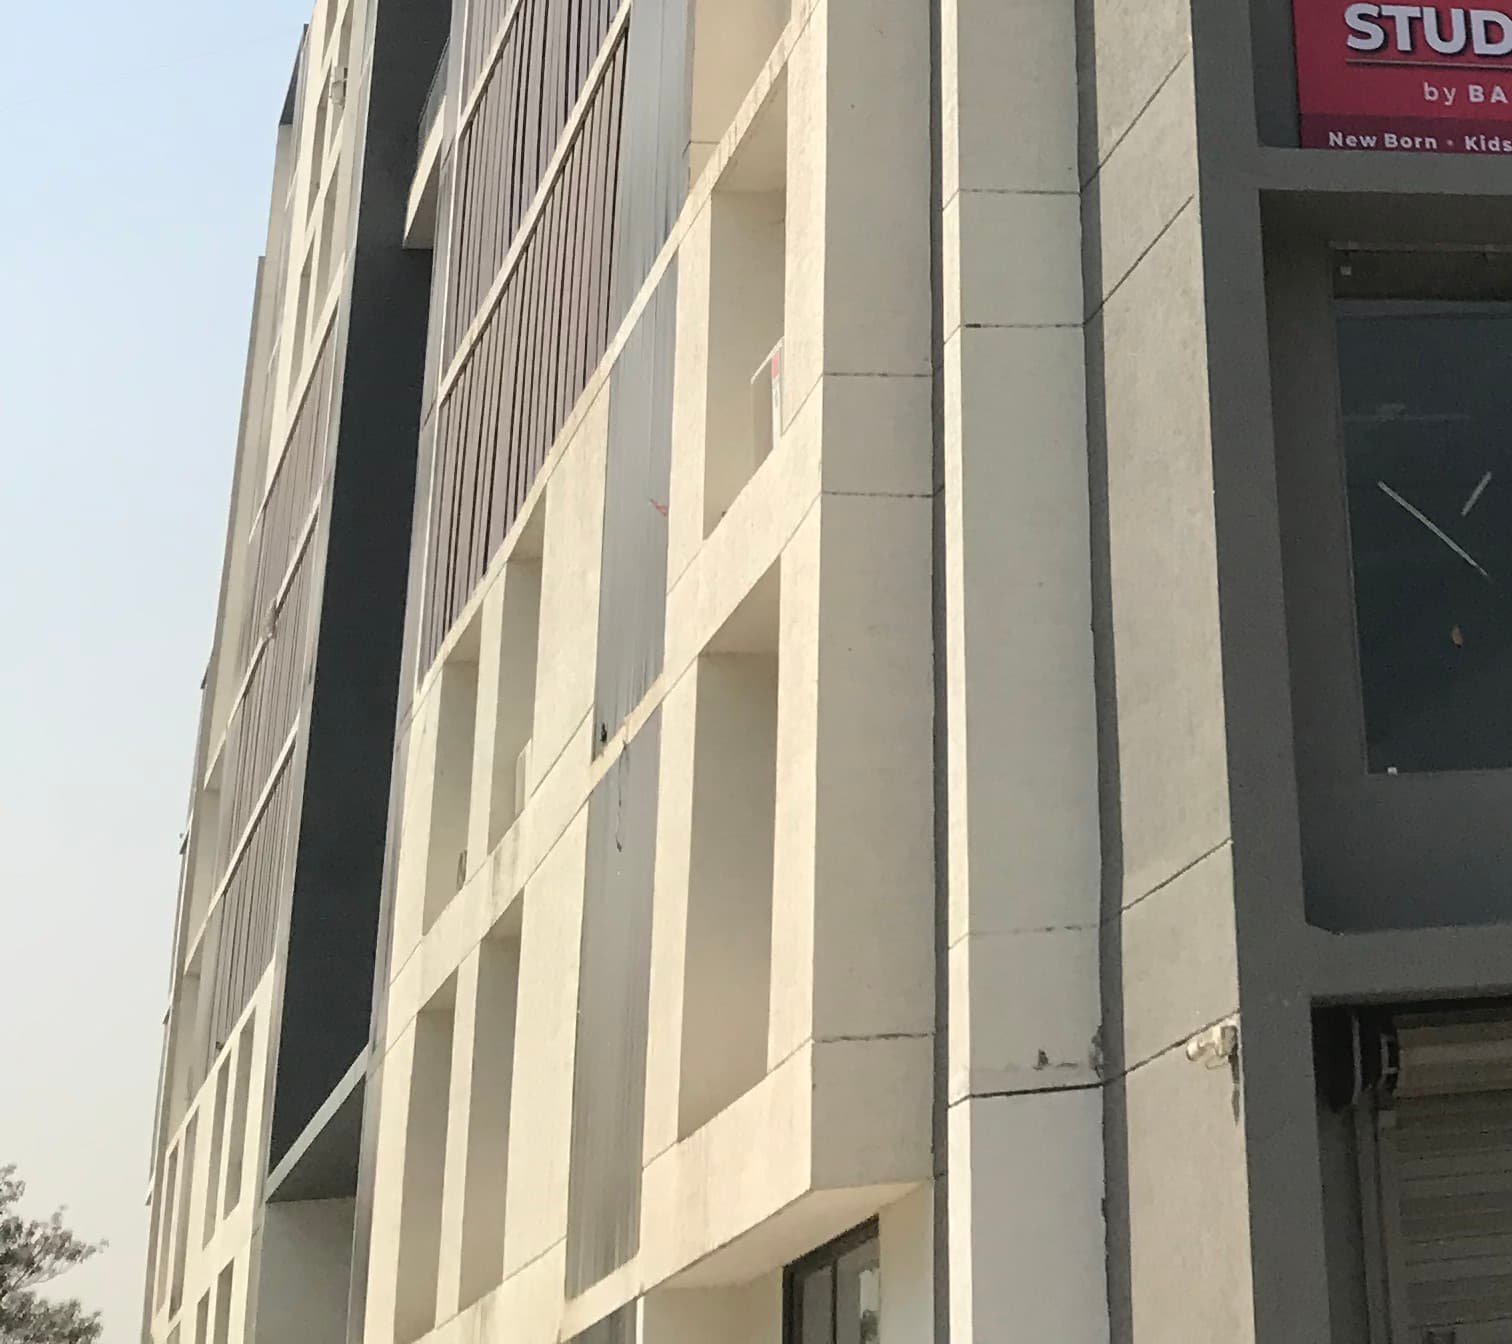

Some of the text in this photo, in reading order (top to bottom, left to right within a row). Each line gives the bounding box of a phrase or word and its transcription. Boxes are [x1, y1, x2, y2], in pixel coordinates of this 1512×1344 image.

[1423, 82, 1456, 106] by
[1329, 131, 1377, 148] New
[1384, 132, 1438, 149] Born
[1465, 135, 1512, 152] Kids
